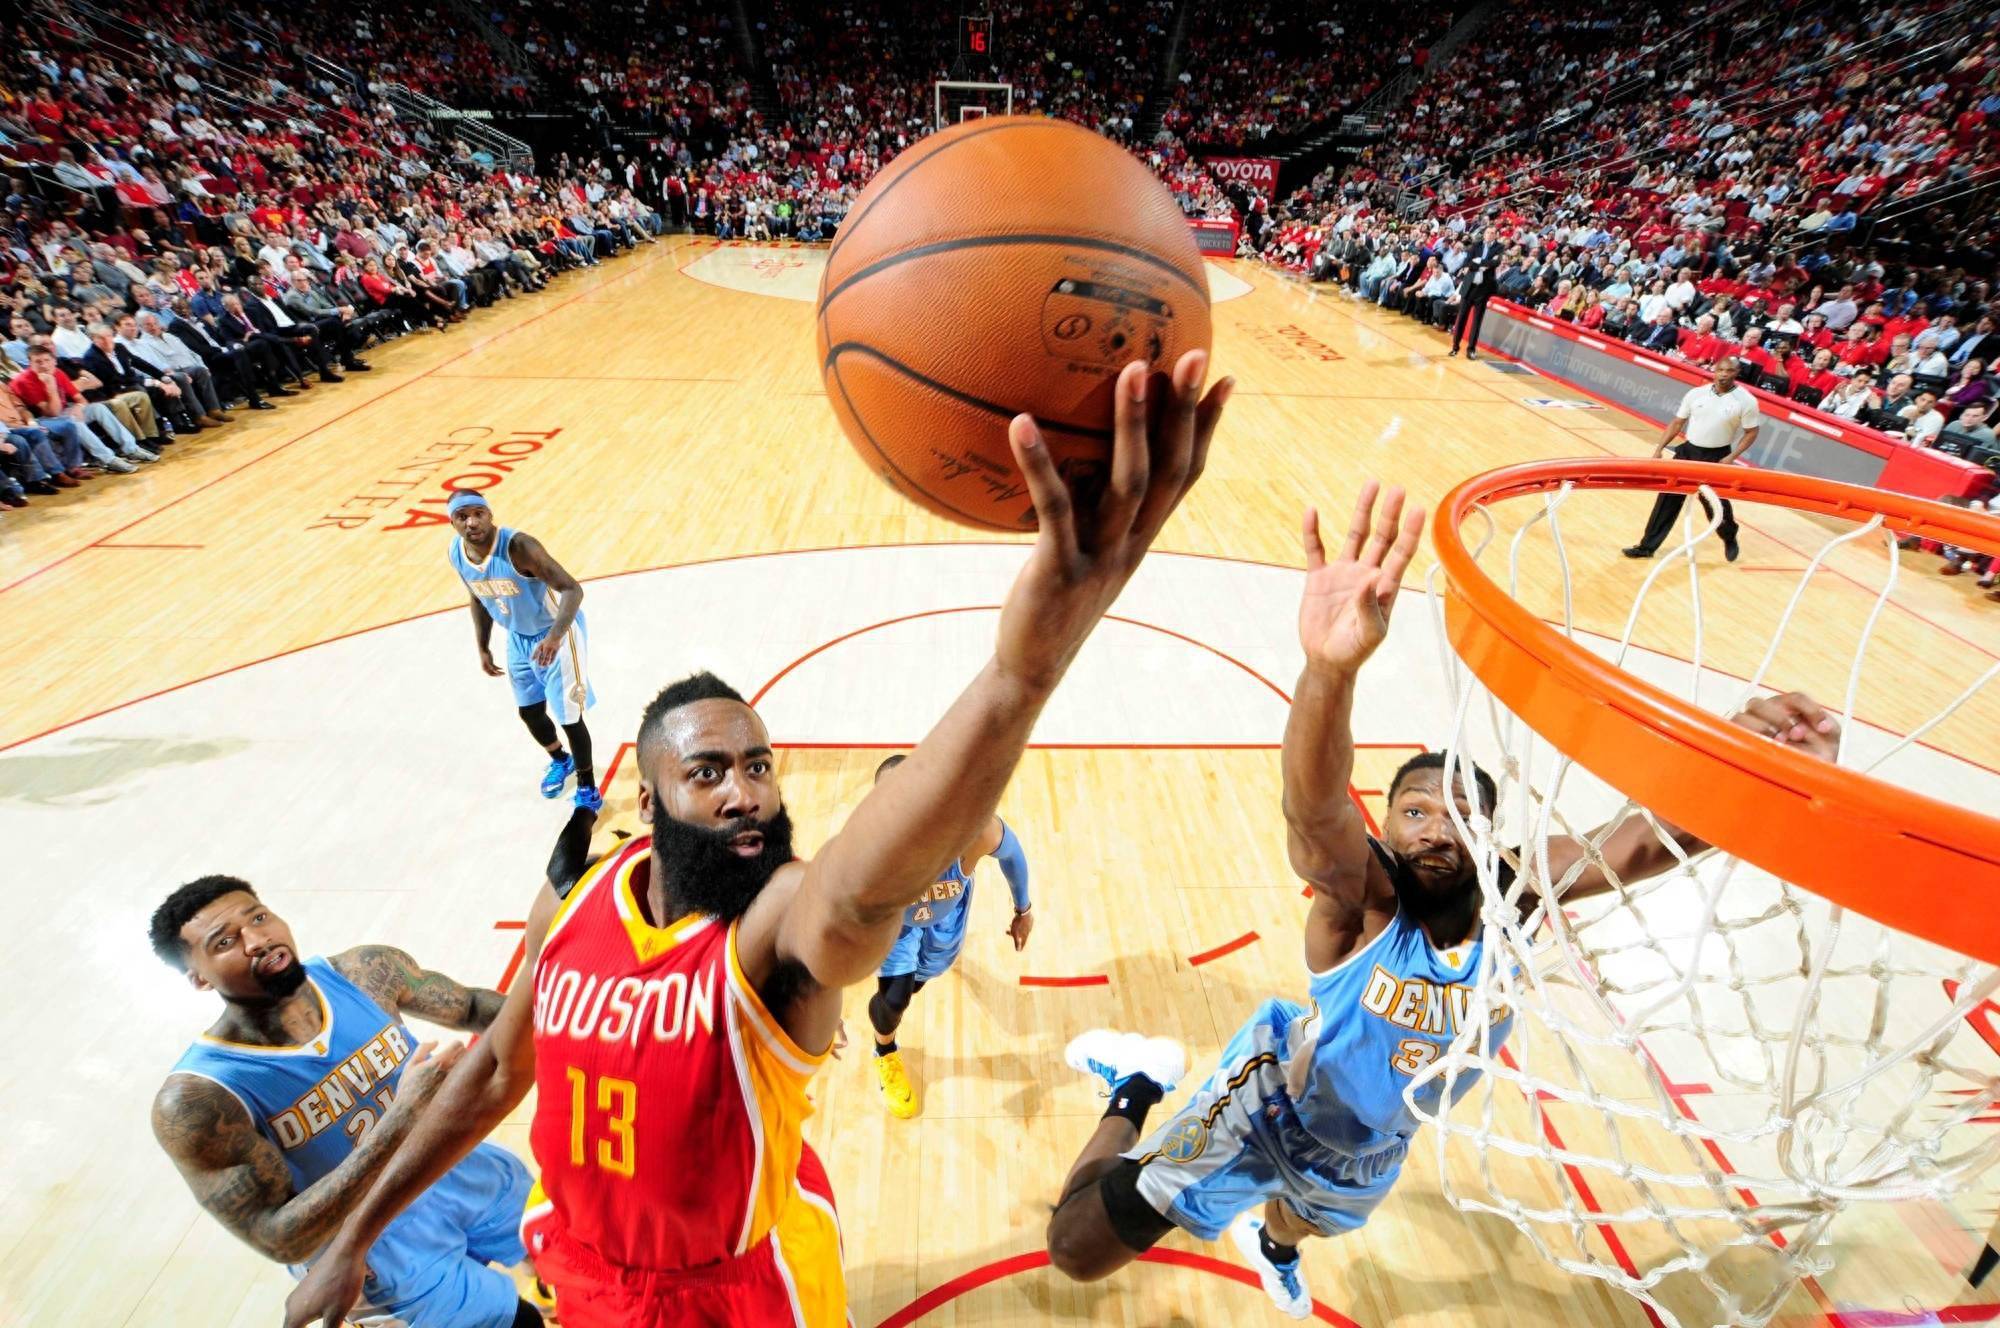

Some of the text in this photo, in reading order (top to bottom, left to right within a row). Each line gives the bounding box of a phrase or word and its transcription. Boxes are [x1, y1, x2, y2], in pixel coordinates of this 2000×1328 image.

[971, 31, 986, 52] 16
[1208, 161, 1272, 180] TOYOTA
[1550, 345, 1611, 386] Tomorrow
[1613, 374, 1660, 405] never
[303, 426, 494, 532] CENTER
[913, 906, 932, 921] 4
[534, 959, 717, 1050] HOUSTON
[1361, 963, 1516, 1037] DENV
[268, 1023, 411, 1151] DENVER
[565, 1064, 638, 1179] 13
